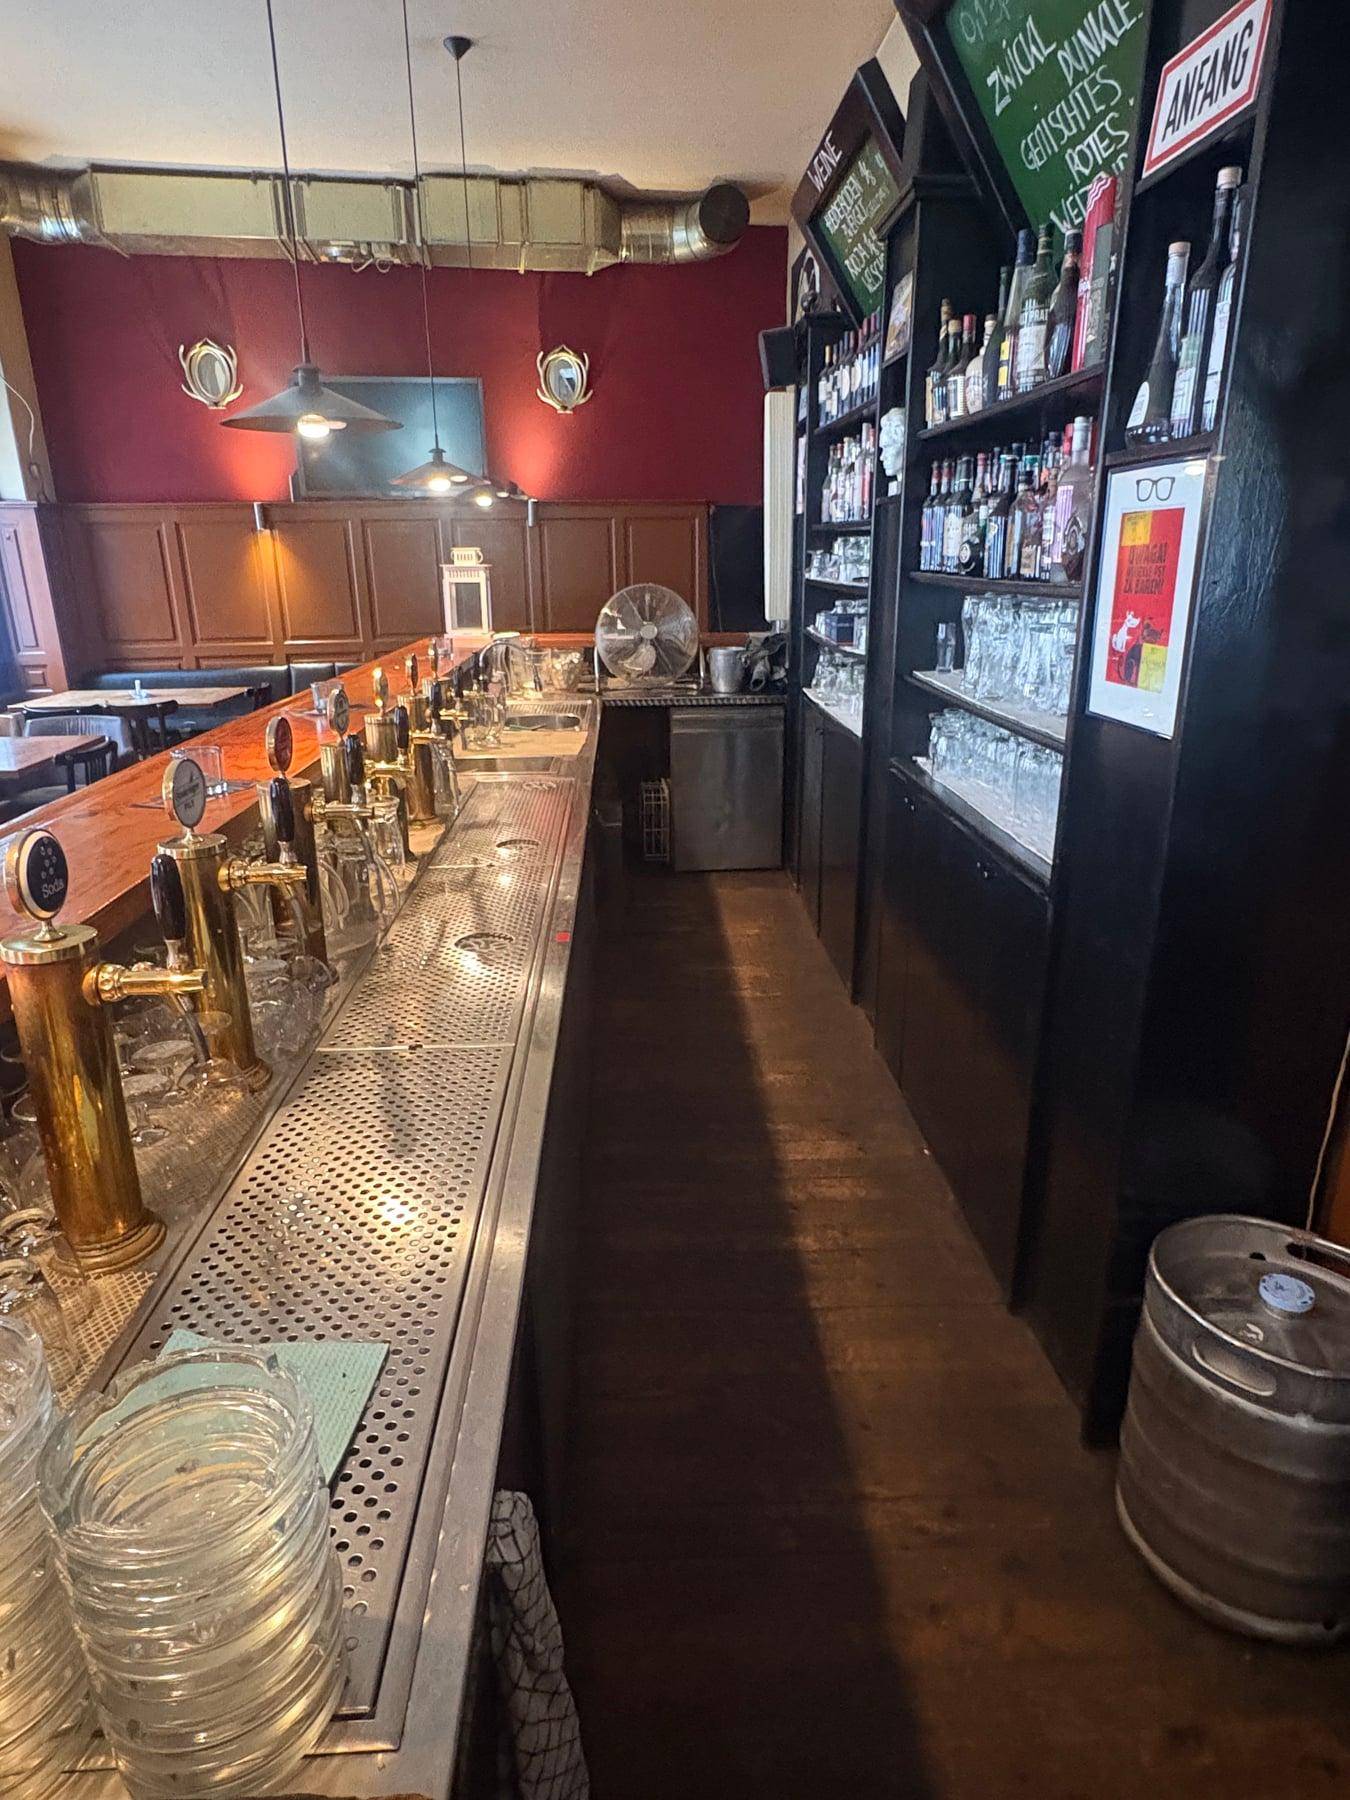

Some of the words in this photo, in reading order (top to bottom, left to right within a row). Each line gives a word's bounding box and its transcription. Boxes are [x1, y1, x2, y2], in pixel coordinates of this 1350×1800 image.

[985, 14, 1056, 116] ZWICKL
[1161, 18, 1254, 143] ANFANG
[807, 130, 843, 193] WEINE
[1064, 111, 1130, 186] ROTES
[42, 878, 65, 898] Soda
